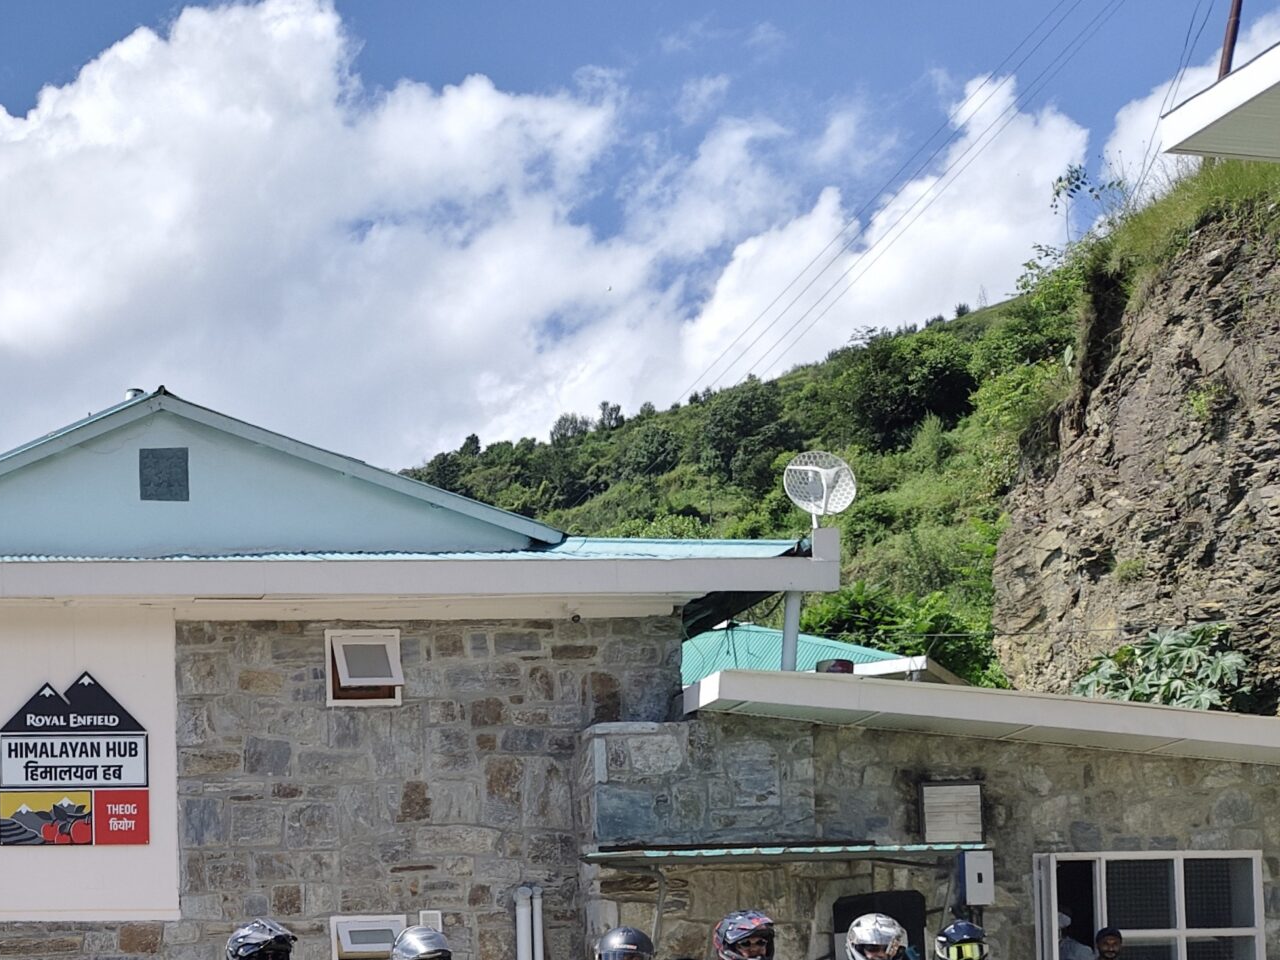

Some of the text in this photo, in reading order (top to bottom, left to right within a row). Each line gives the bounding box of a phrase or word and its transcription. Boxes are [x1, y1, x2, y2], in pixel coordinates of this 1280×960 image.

[26, 713, 120, 728] ROYAL ENFIELD
[7, 741, 139, 759] HIMALAYAN HUB
[23, 760, 124, 782] हिमालयन हब
[106, 804, 138, 815] THEOG
